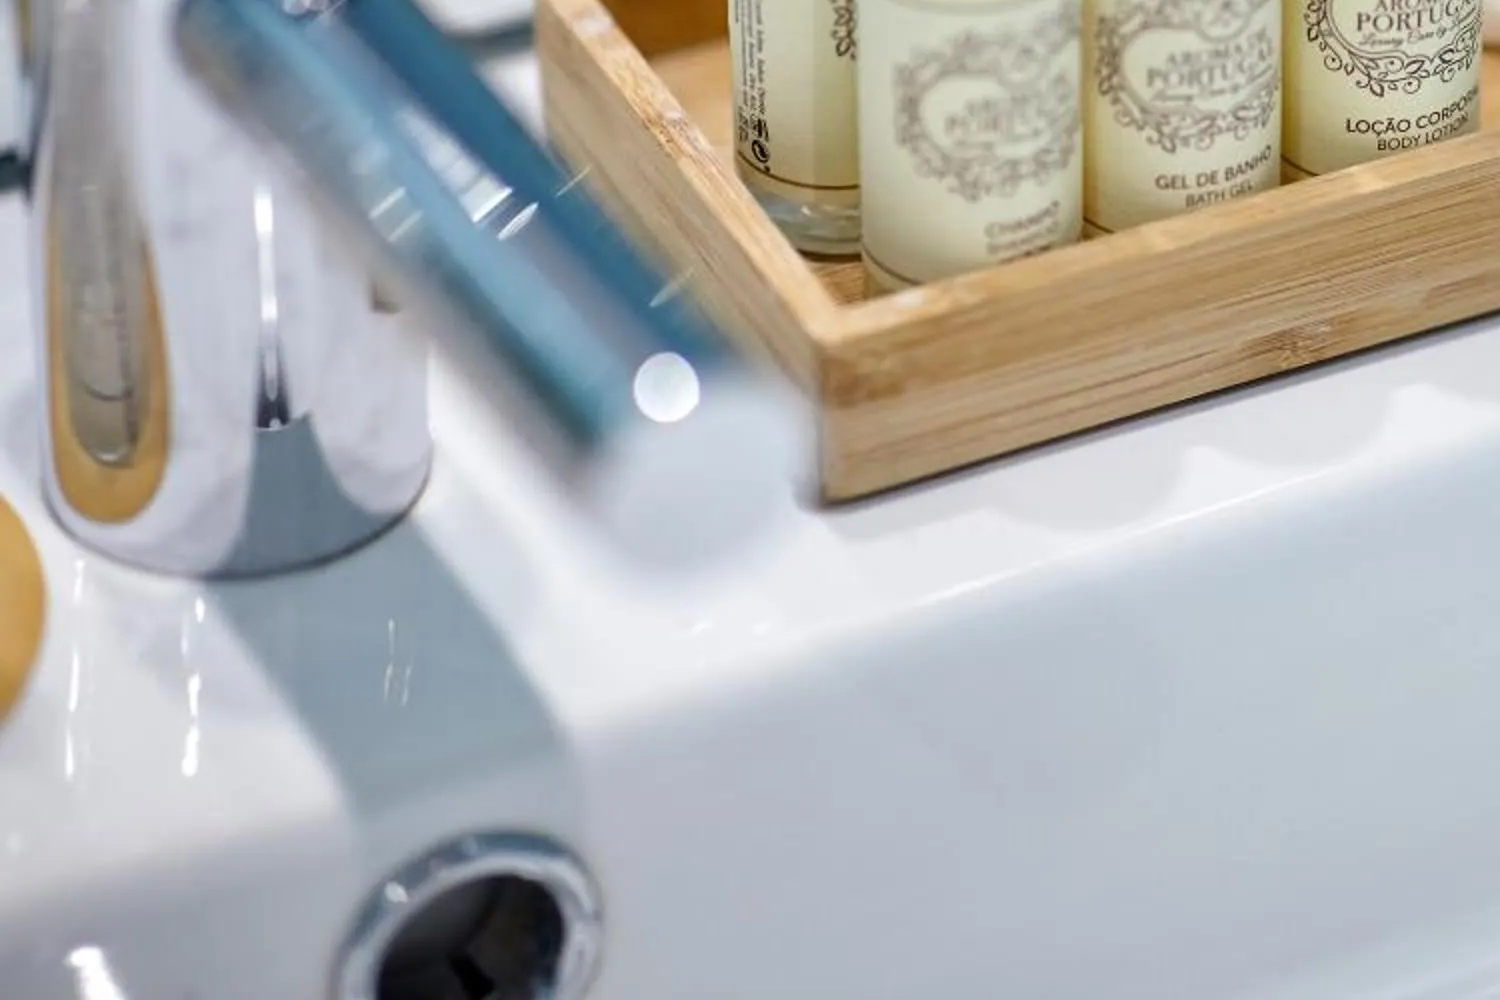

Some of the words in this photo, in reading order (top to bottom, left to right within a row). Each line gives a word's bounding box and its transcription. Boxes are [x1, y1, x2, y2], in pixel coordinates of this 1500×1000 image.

[1346, 117, 1411, 136] LOÇÃO
[1377, 134, 1421, 151] BODY
[1425, 111, 1469, 144] LOTION
[1155, 174, 1190, 191] GEL
[1196, 169, 1219, 187] DE
[1224, 144, 1272, 182] BANHO
[1185, 185, 1225, 208] BATH
